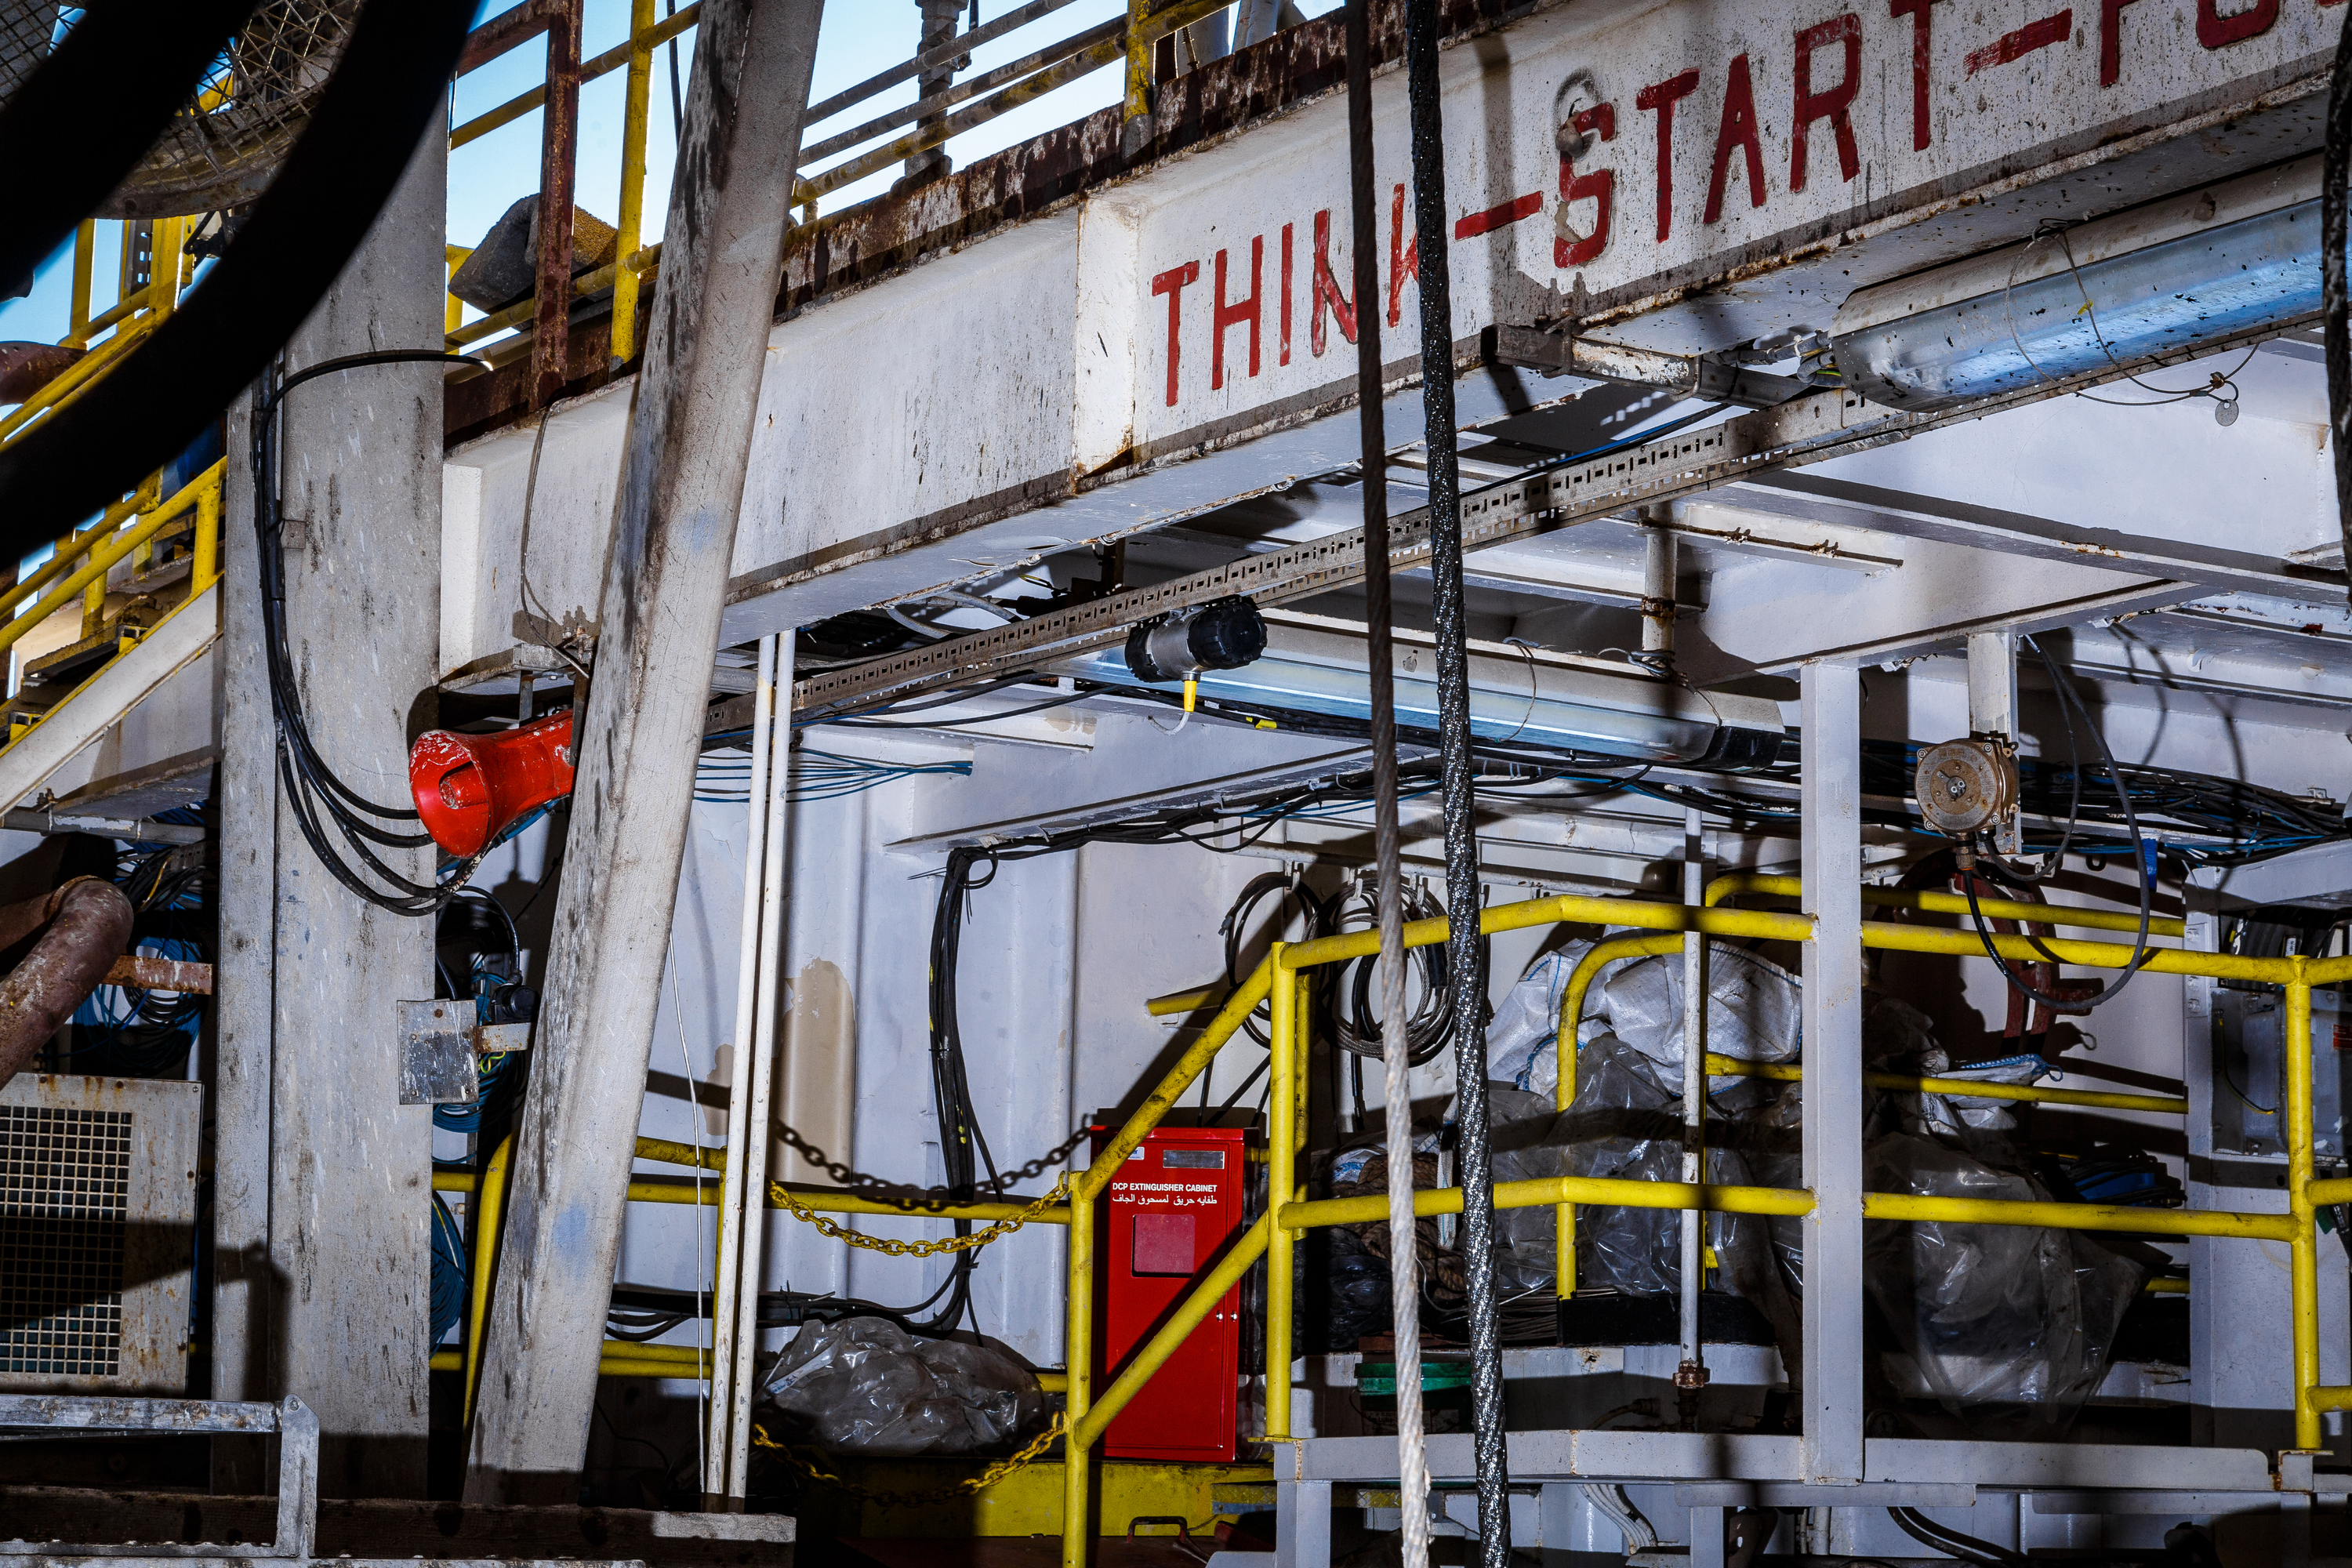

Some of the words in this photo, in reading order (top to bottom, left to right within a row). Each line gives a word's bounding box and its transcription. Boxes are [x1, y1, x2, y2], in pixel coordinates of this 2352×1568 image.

[1112, 1182, 1128, 1191] DCP
[1130, 1183, 1184, 1192] EXTINGUISHER
[1185, 1184, 1218, 1192] CABINET
